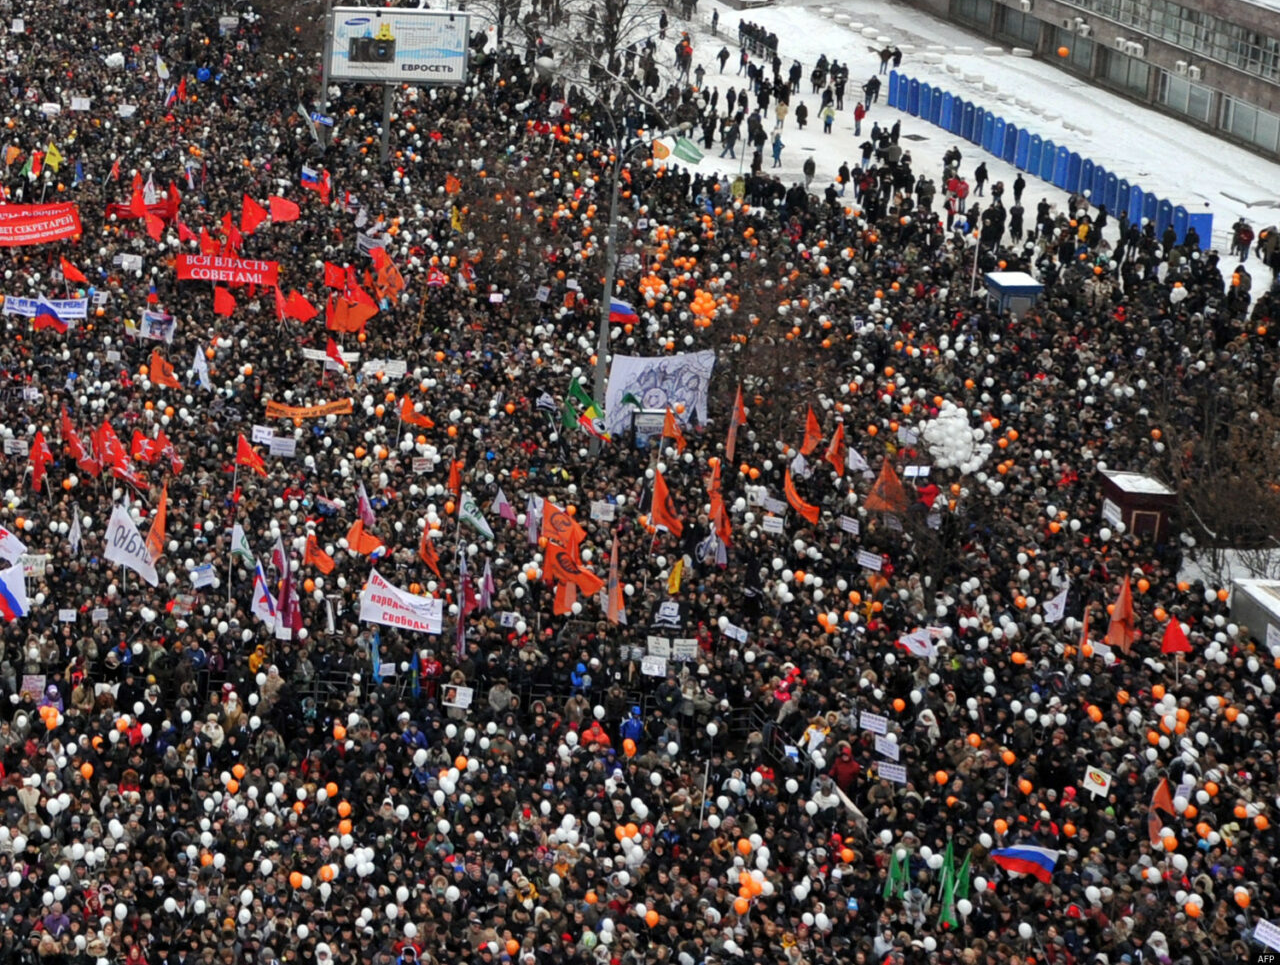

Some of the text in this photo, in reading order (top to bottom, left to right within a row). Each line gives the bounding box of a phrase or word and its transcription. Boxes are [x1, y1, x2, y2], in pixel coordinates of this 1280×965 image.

[401, 63, 454, 73] ЕВРОСЕТЬ
[14, 214, 74, 234] СЕКРЕТАРЕЙ
[186, 255, 269, 271] ВСЯ ВЛАСТЬ
[190, 267, 262, 283] СОВЕТАМ!
